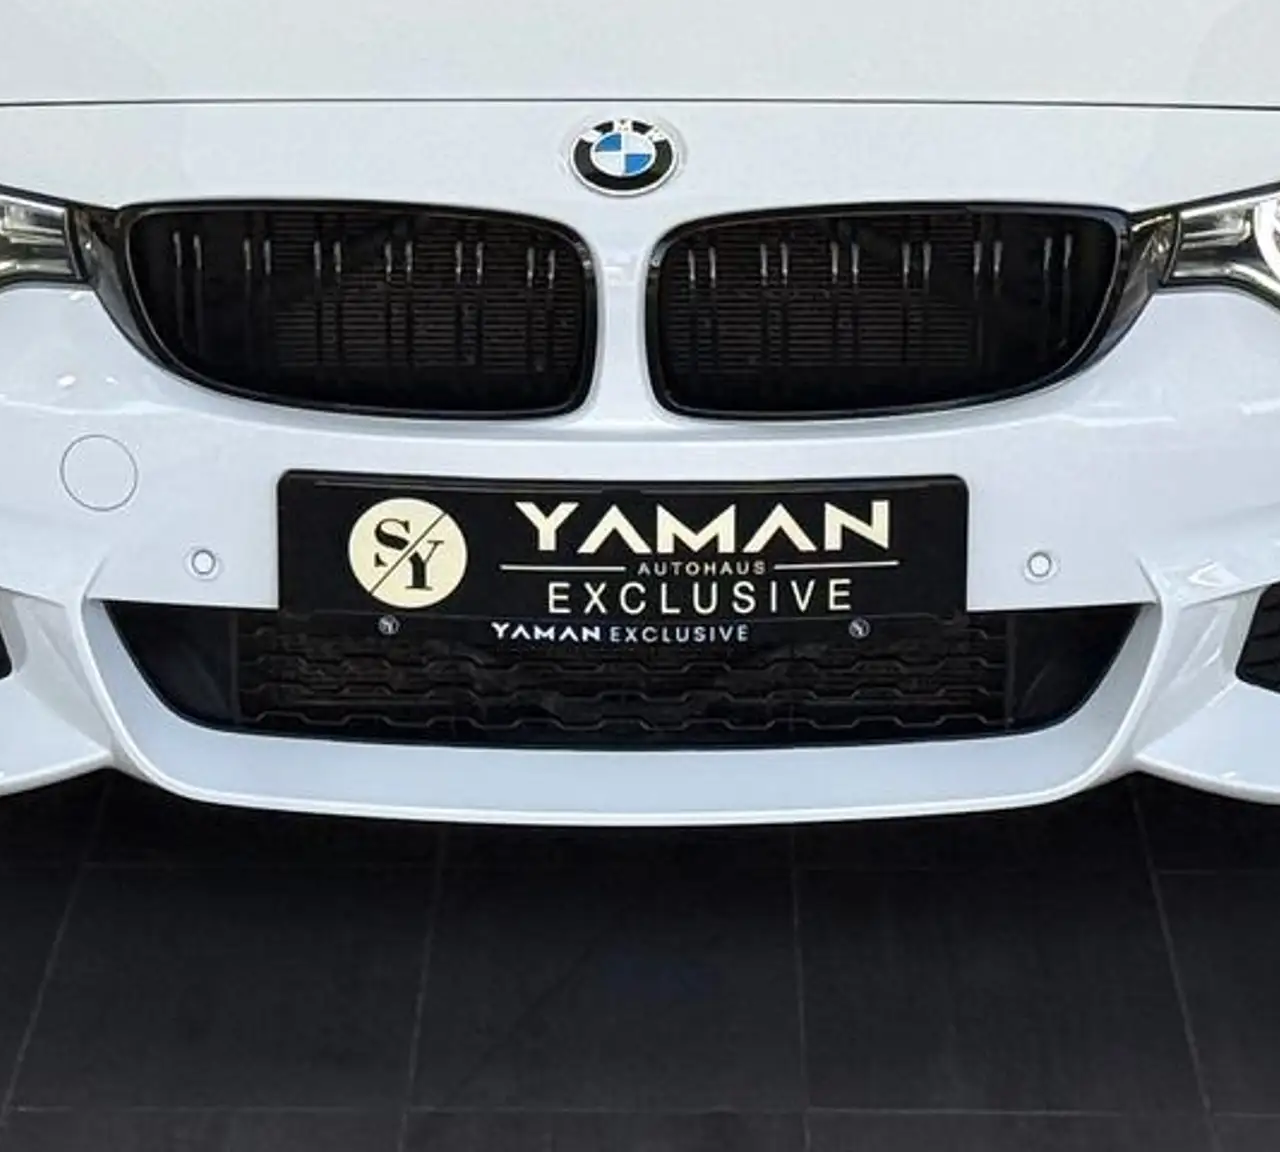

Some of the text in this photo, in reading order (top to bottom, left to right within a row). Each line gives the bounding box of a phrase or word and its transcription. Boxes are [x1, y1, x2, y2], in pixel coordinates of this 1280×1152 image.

[515, 499, 890, 554] YAMAN
[637, 561, 766, 576] AUTOHAUS
[547, 578, 853, 615] EXCLUSIVE
[491, 621, 750, 643] YAMAN EXCLUSIVE
